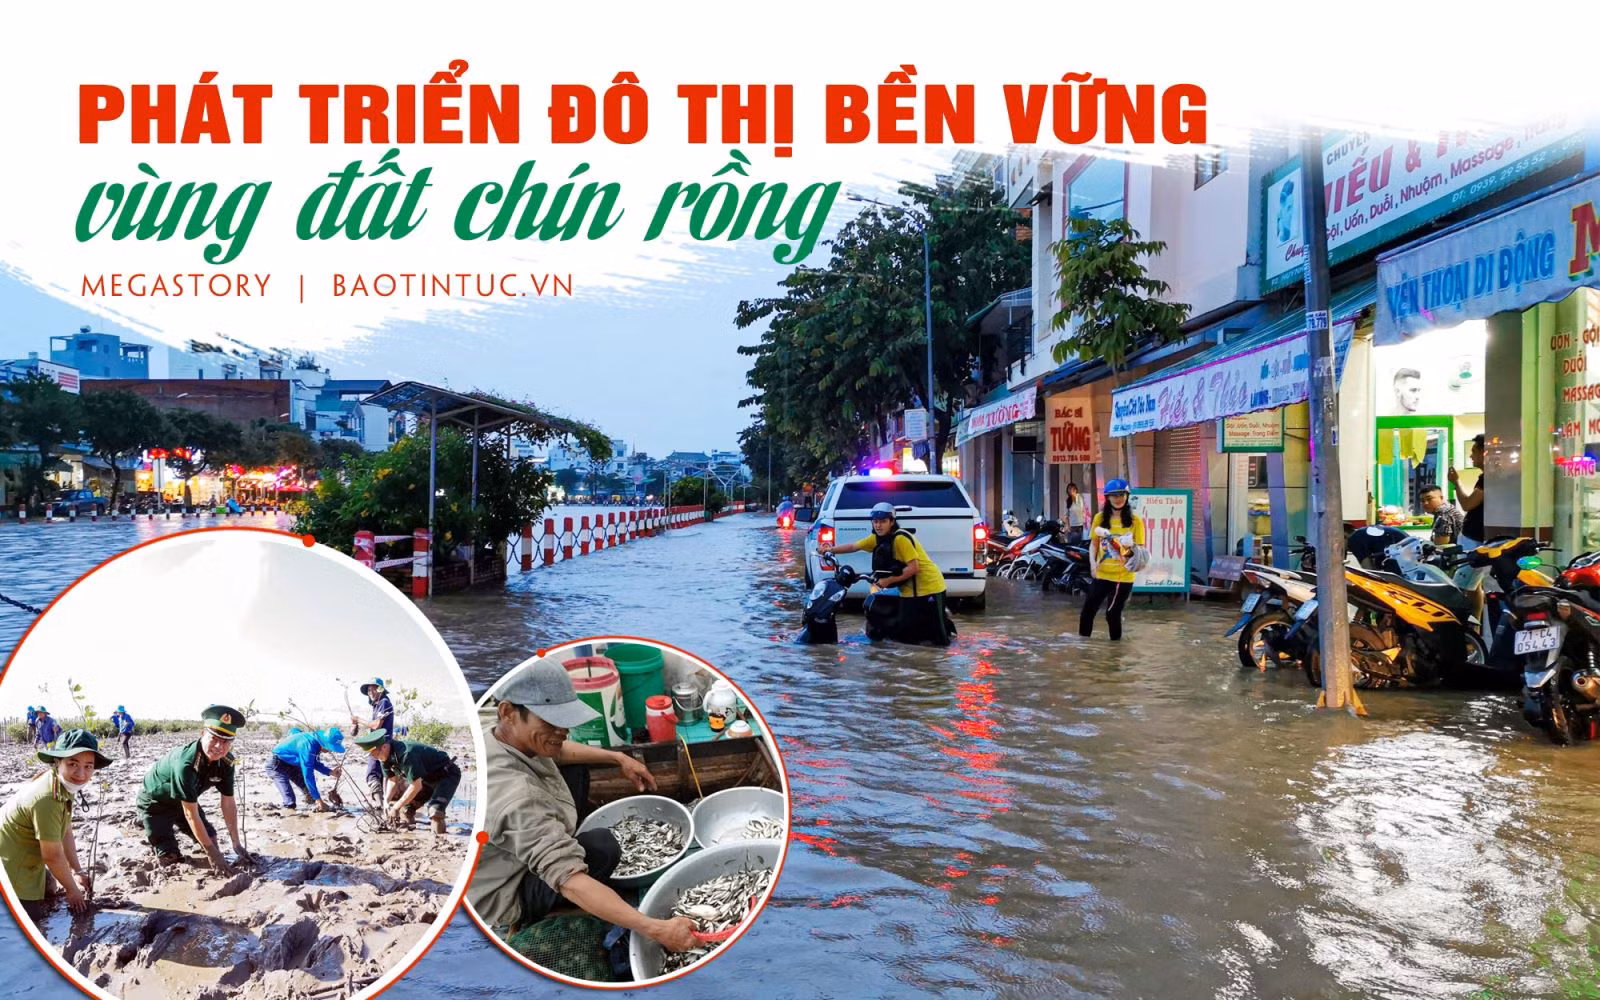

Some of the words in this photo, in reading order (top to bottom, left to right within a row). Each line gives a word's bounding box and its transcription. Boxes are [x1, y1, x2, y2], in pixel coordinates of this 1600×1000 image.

[1324, 143, 1394, 219] IẾU
[1421, 259, 1471, 311] THOẠI
[1474, 252, 1496, 299] DI
[1498, 228, 1557, 296] ĐỘNG
[1055, 406, 1073, 418] BÁC
[1160, 506, 1185, 560] TÓC
